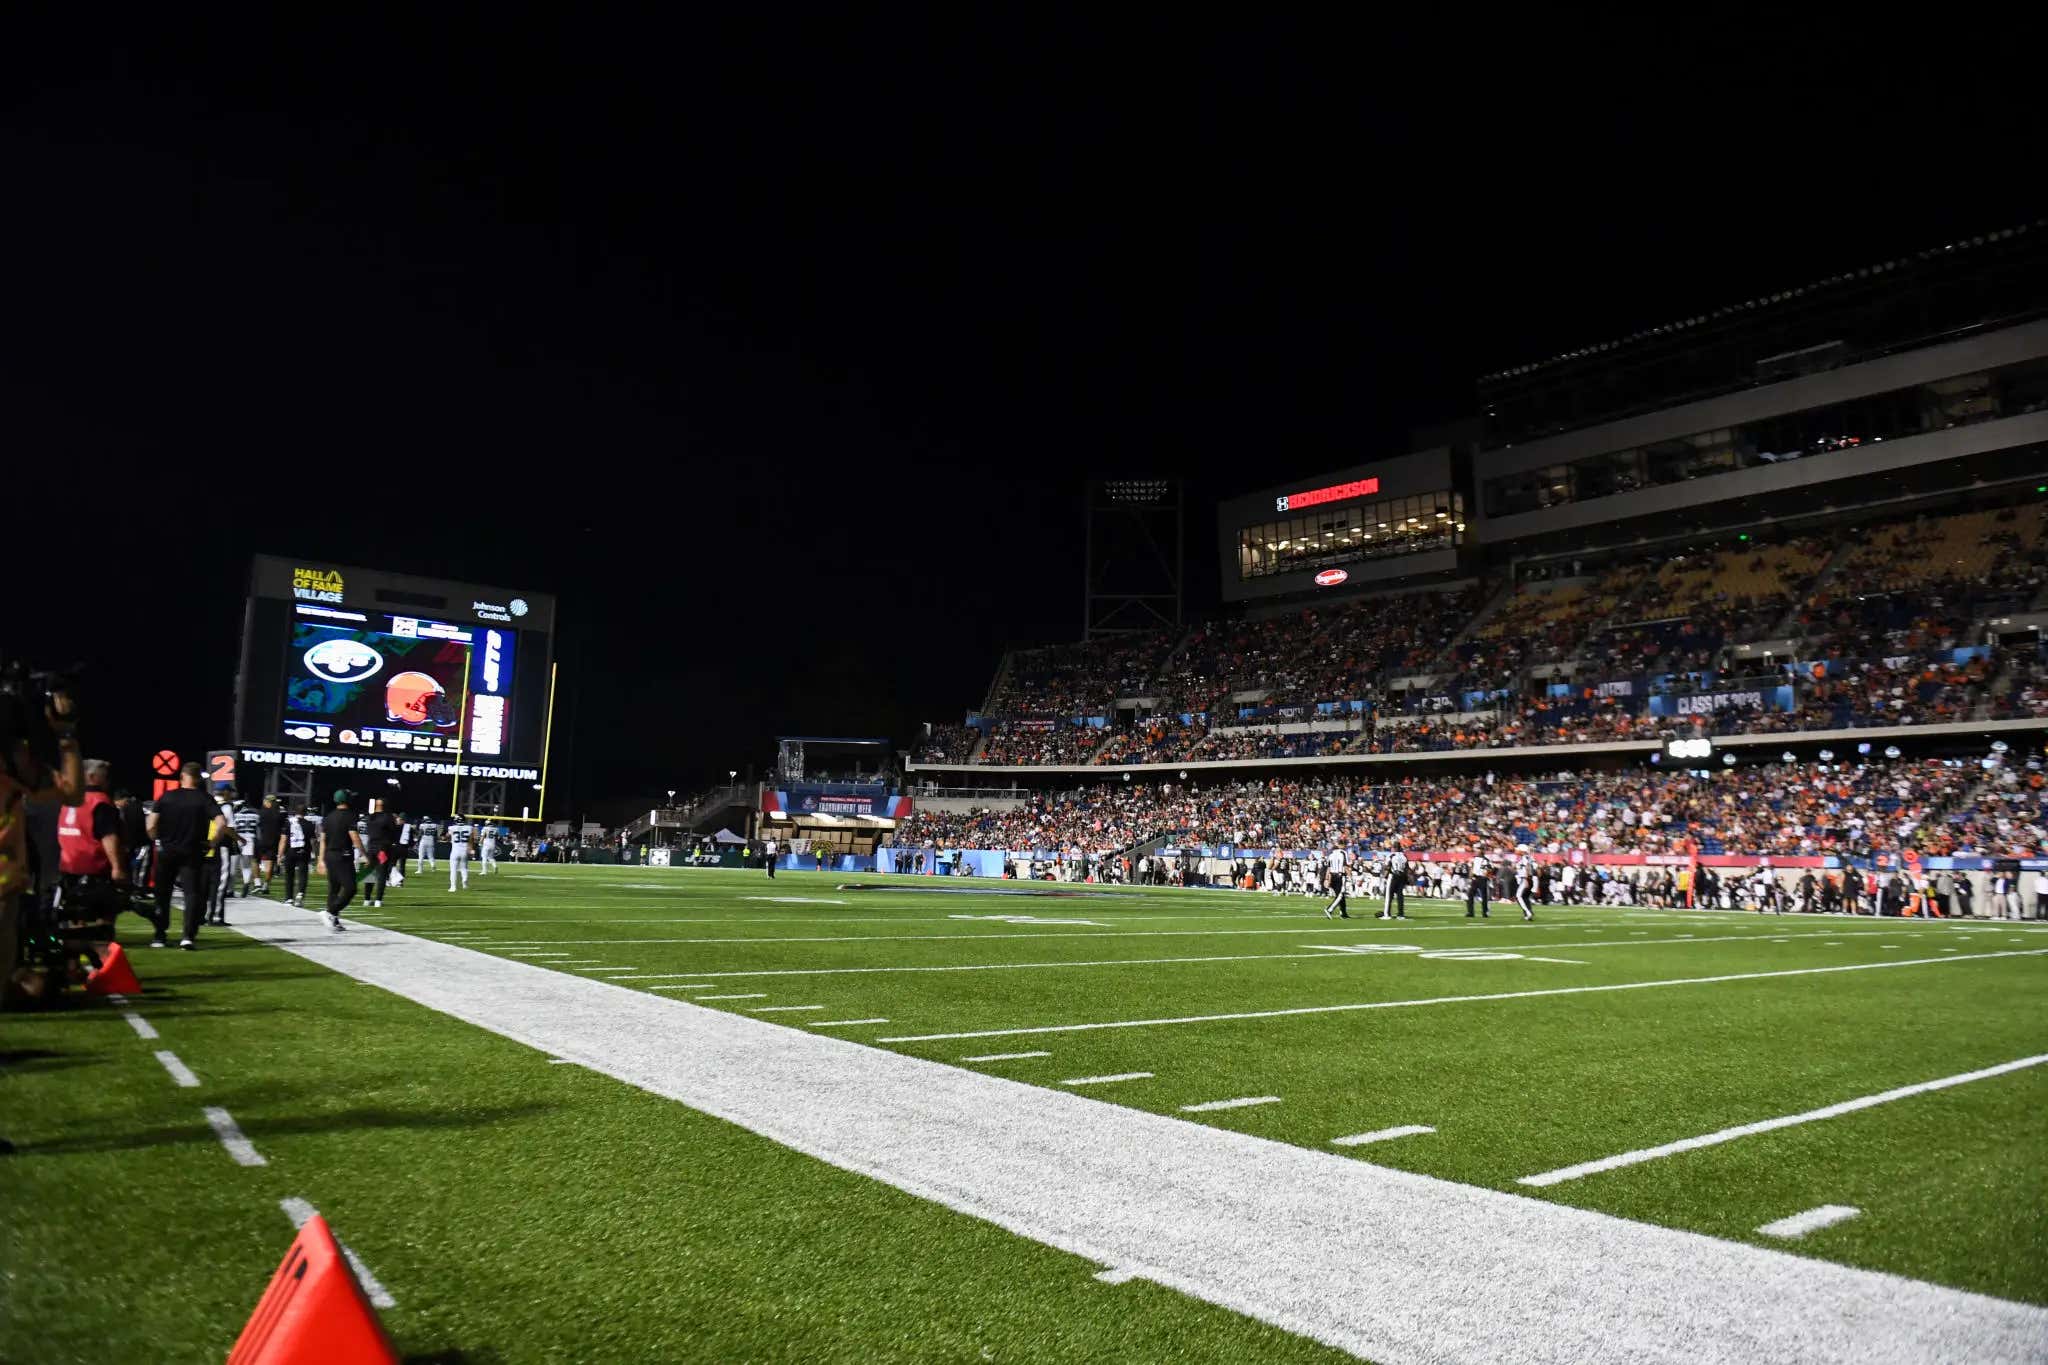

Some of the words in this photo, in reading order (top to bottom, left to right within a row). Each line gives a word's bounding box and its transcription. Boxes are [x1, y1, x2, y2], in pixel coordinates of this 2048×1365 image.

[294, 568, 323, 581] HALL
[293, 578, 311, 589] OF
[311, 580, 344, 593] FAME
[293, 587, 344, 603] VILLAGE
[472, 601, 506, 613] Johnson
[477, 610, 512, 622] Controls
[1677, 695, 1713, 714] CLASS
[210, 754, 235, 781] 2
[242, 750, 282, 764] TOM
[284, 753, 355, 769] BENSON
[357, 758, 399, 771] HALL
[401, 761, 425, 773] OF
[426, 763, 469, 776] FAME
[471, 766, 538, 780] STADIUM
[453, 830, 469, 844] 35
